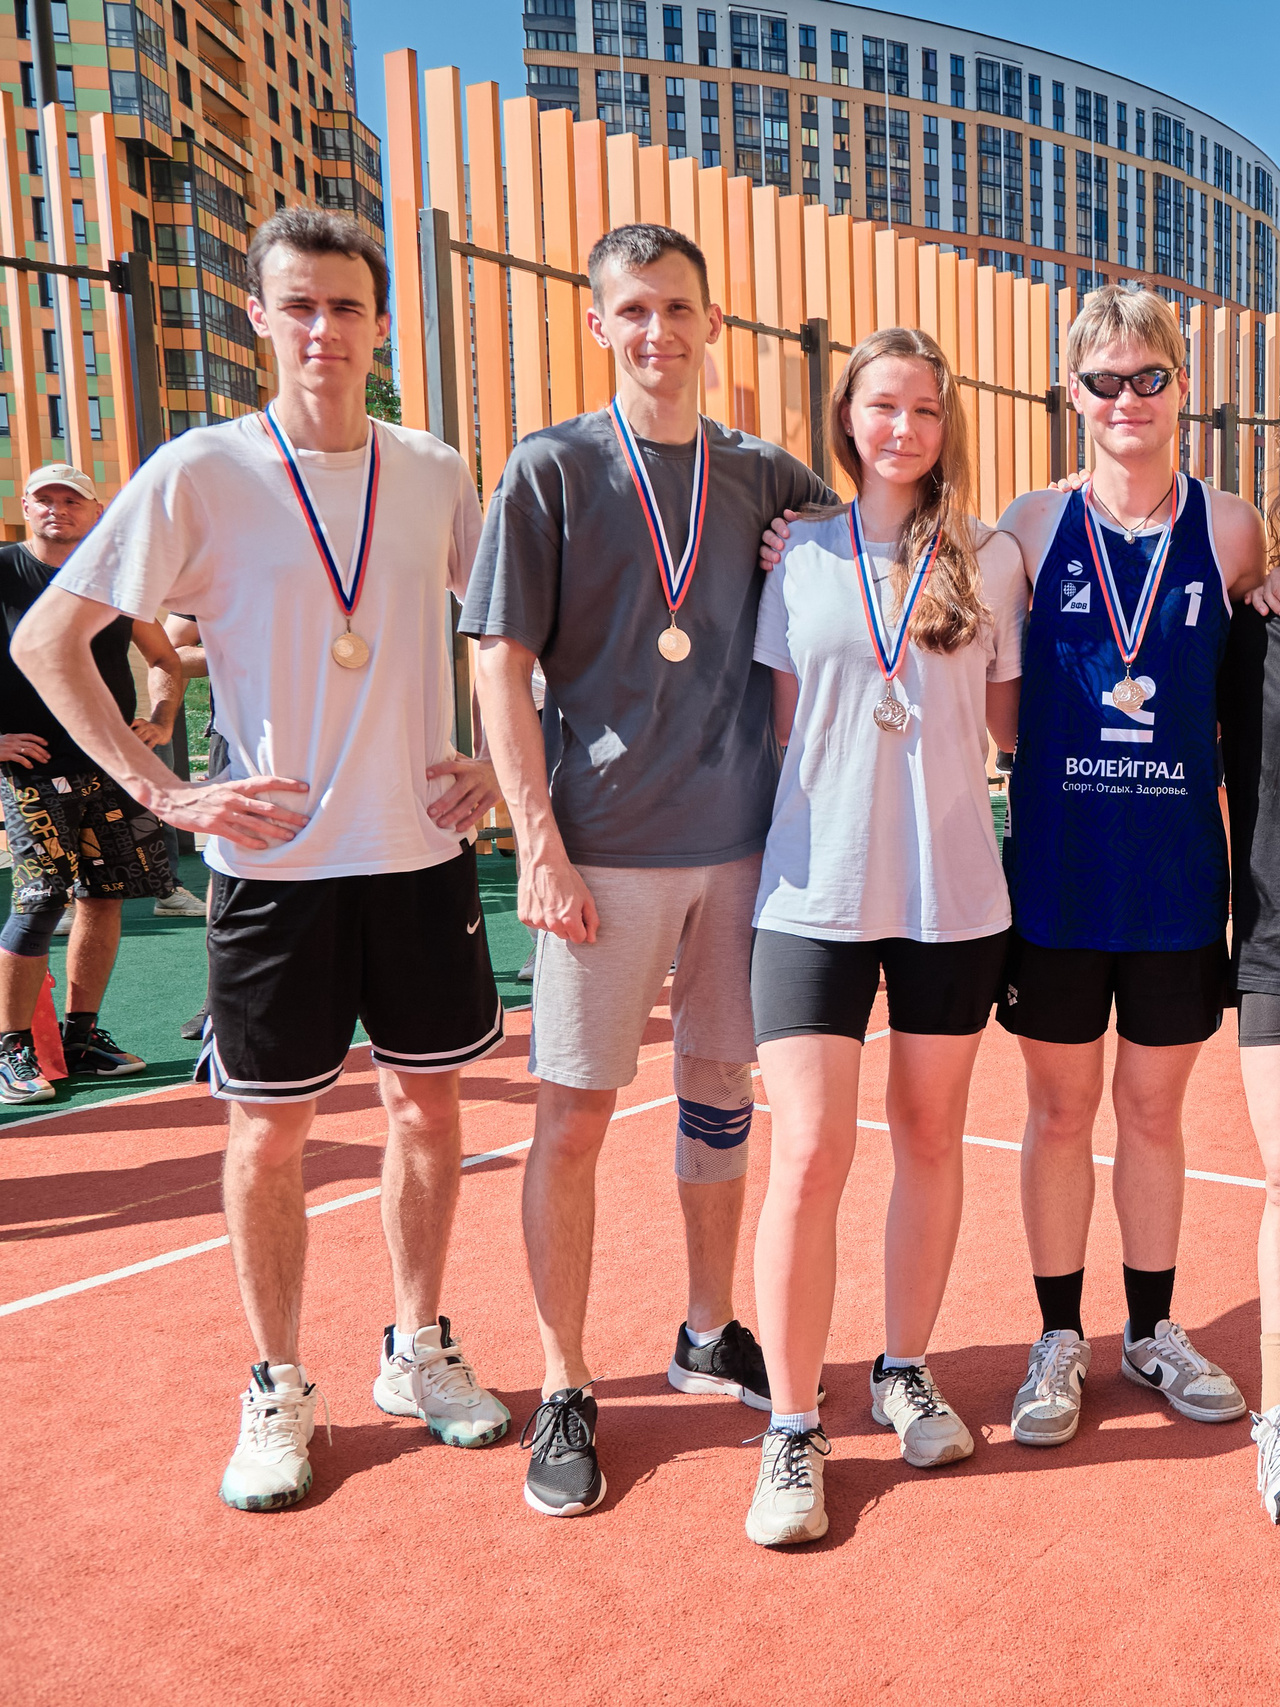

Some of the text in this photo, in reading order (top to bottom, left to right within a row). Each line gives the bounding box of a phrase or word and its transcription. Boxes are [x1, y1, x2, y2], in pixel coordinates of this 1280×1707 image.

[1070, 601, 1088, 610] ВФВ
[1185, 581, 1204, 627] 1
[1066, 756, 1185, 780] ВОЛЕЙГРАД
[1062, 781, 1189, 797] Спорт. Отдых. Здоровье.
[15, 786, 60, 839] SURF
